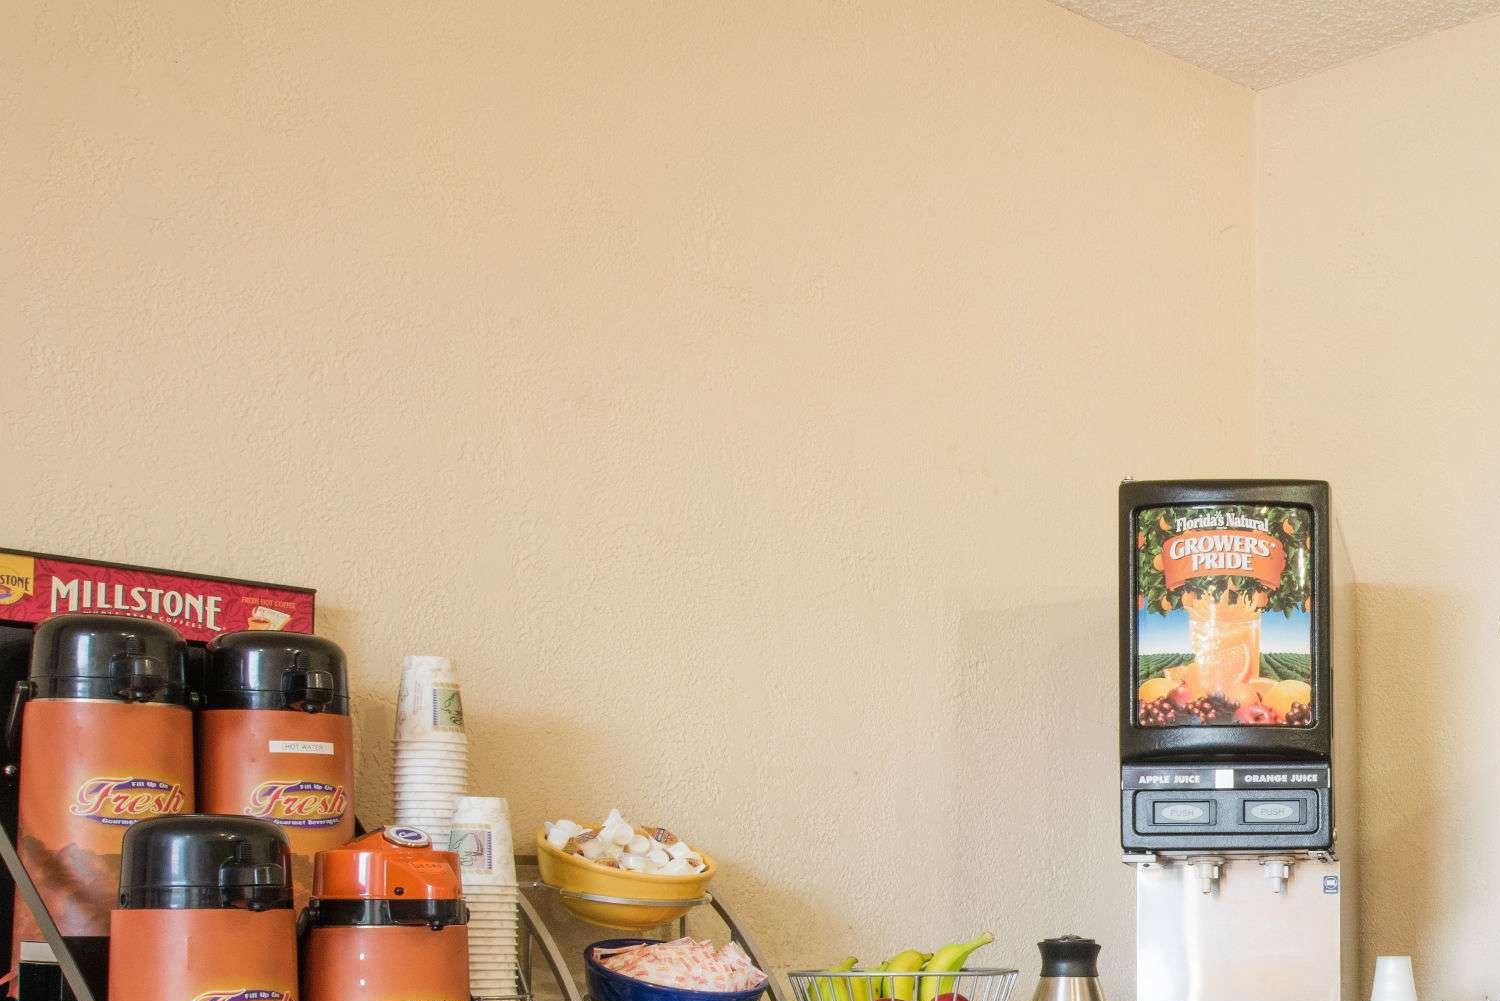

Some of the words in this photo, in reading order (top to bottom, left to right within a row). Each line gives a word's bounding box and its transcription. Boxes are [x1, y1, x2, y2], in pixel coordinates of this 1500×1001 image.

[1175, 511, 1225, 532] Florida's
[1226, 513, 1269, 532] Natural
[1191, 552, 1254, 571] PRIDE
[51, 575, 223, 632] MILLSTONE
[1138, 775, 1170, 784] APPLE
[1173, 775, 1201, 784] JUICE
[1244, 774, 1288, 783] ORANGE
[1290, 774, 1318, 782] JUICE
[69, 777, 184, 816] Fresh
[243, 779, 345, 818] Fresh
[1169, 808, 1194, 817] PUSH
[1260, 807, 1286, 815] PUSH
